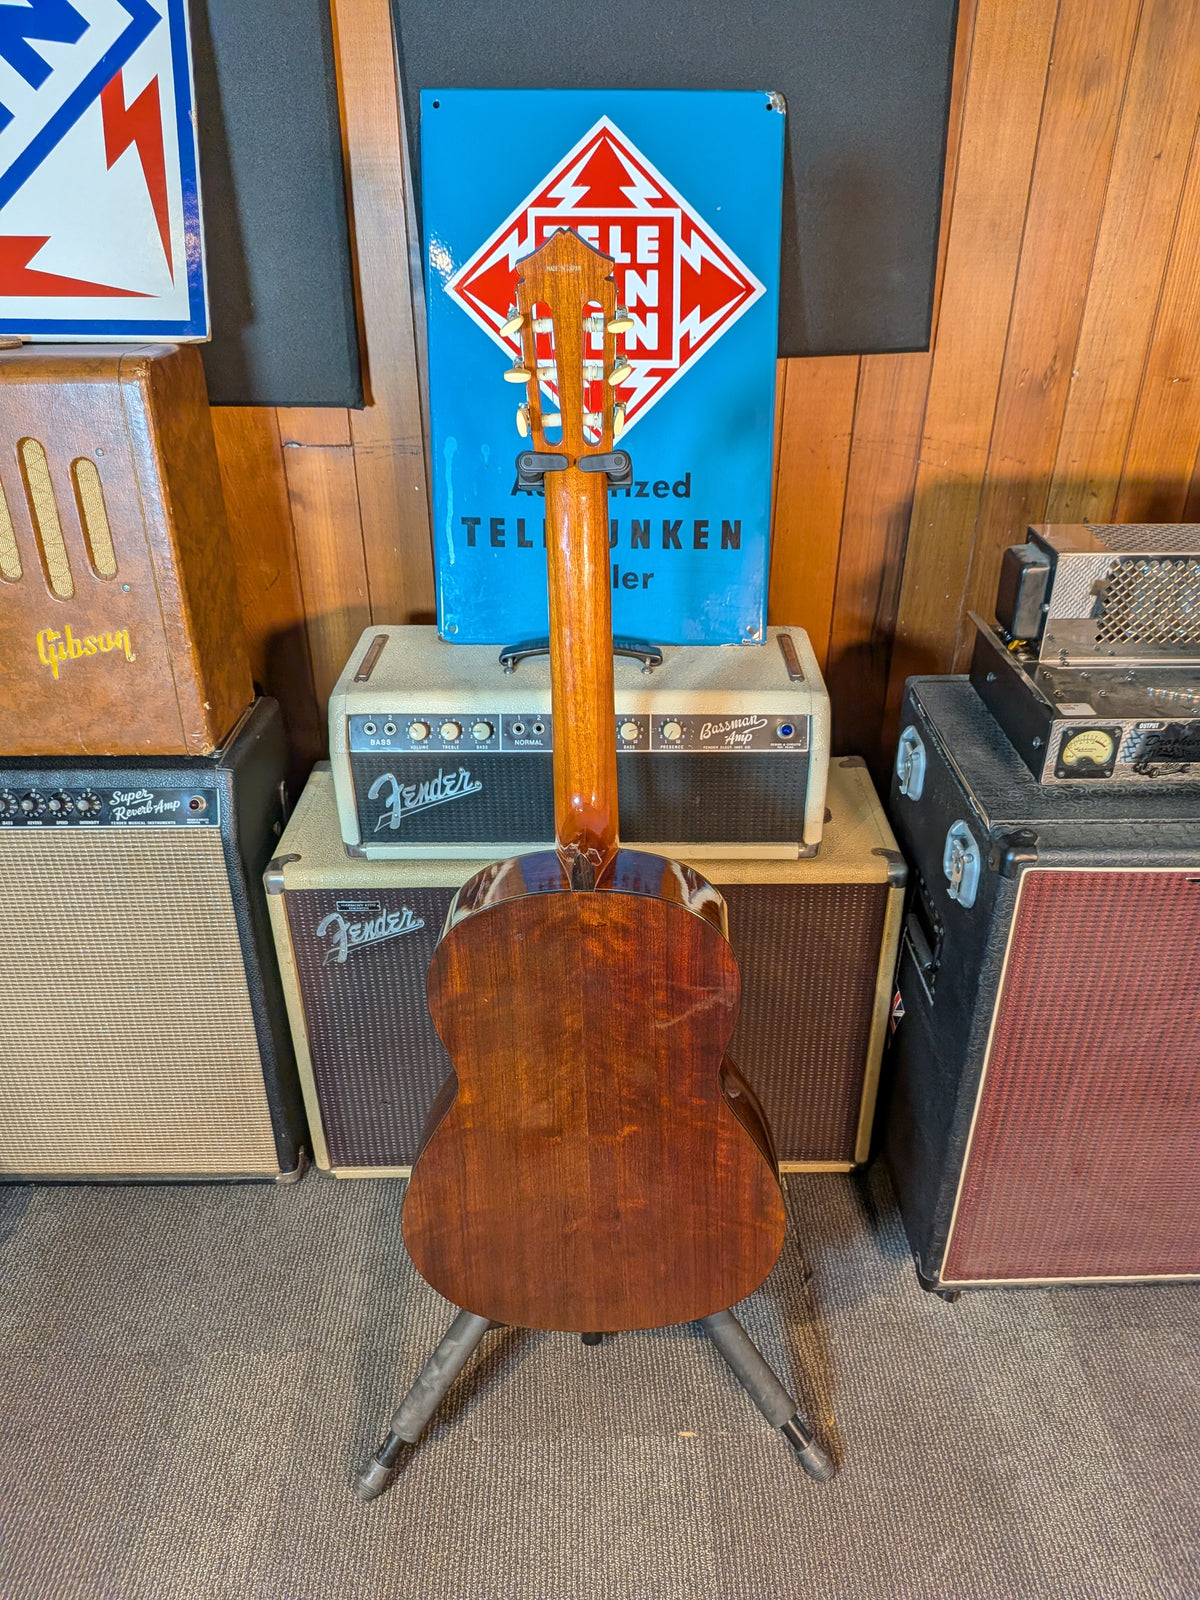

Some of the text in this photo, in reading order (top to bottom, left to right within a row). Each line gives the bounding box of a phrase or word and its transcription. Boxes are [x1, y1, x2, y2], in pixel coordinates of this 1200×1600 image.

[461, 516, 742, 550] TELNKEN
[36, 624, 136, 679] Gibson
[370, 738, 392, 746] BASS
[699, 715, 768, 740] Bassman
[108, 789, 154, 806] Super
[368, 768, 482, 832] Fender
[316, 906, 425, 966] Fender
